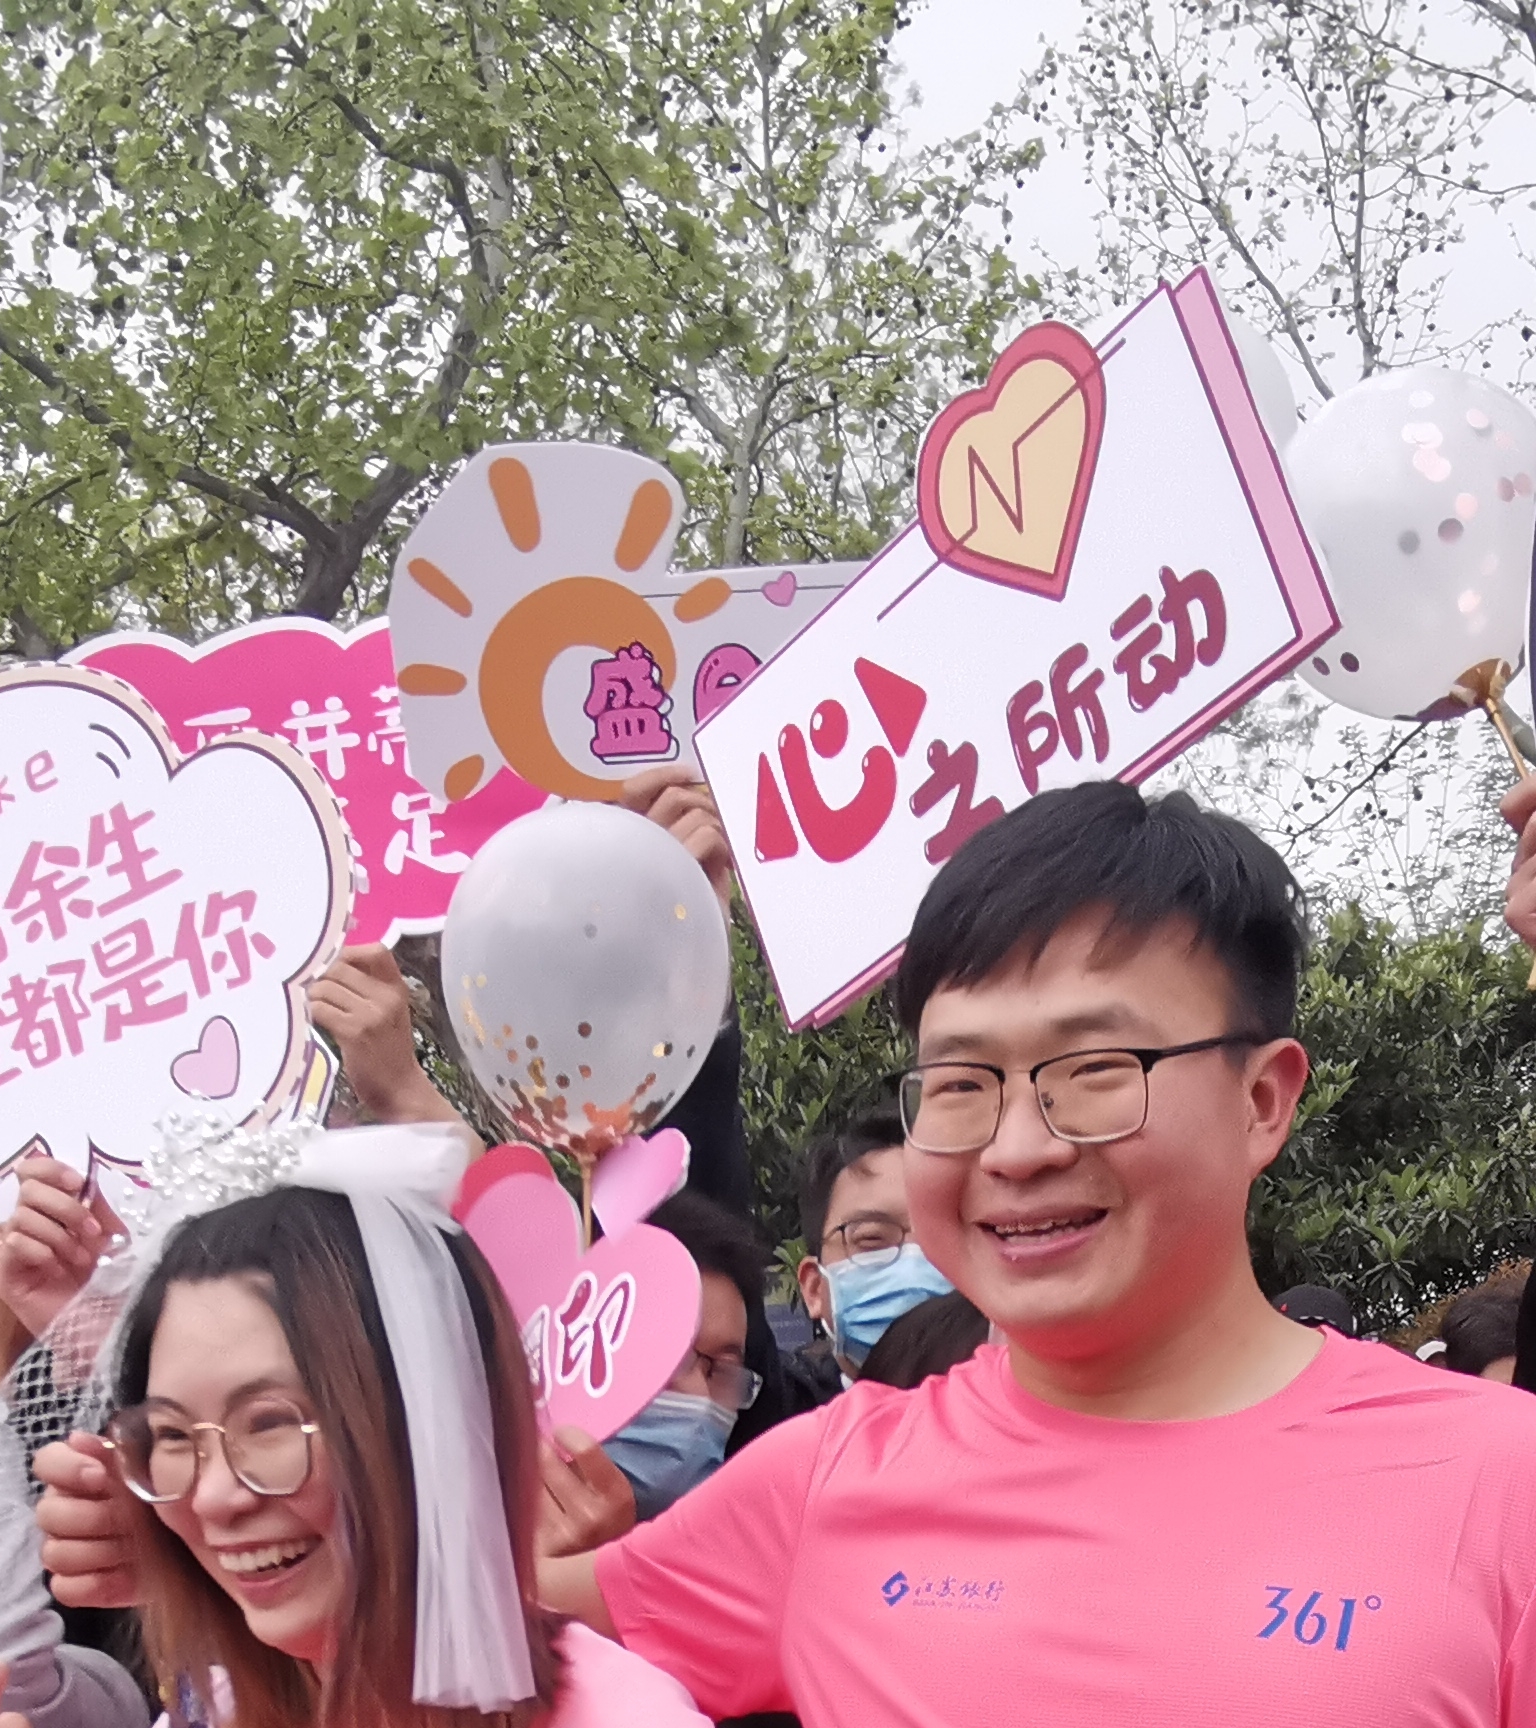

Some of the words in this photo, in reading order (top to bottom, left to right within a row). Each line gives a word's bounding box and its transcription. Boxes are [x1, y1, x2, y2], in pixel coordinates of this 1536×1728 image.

[754, 565, 1228, 867] 心之所动
[1255, 1584, 1383, 1652] 361°
